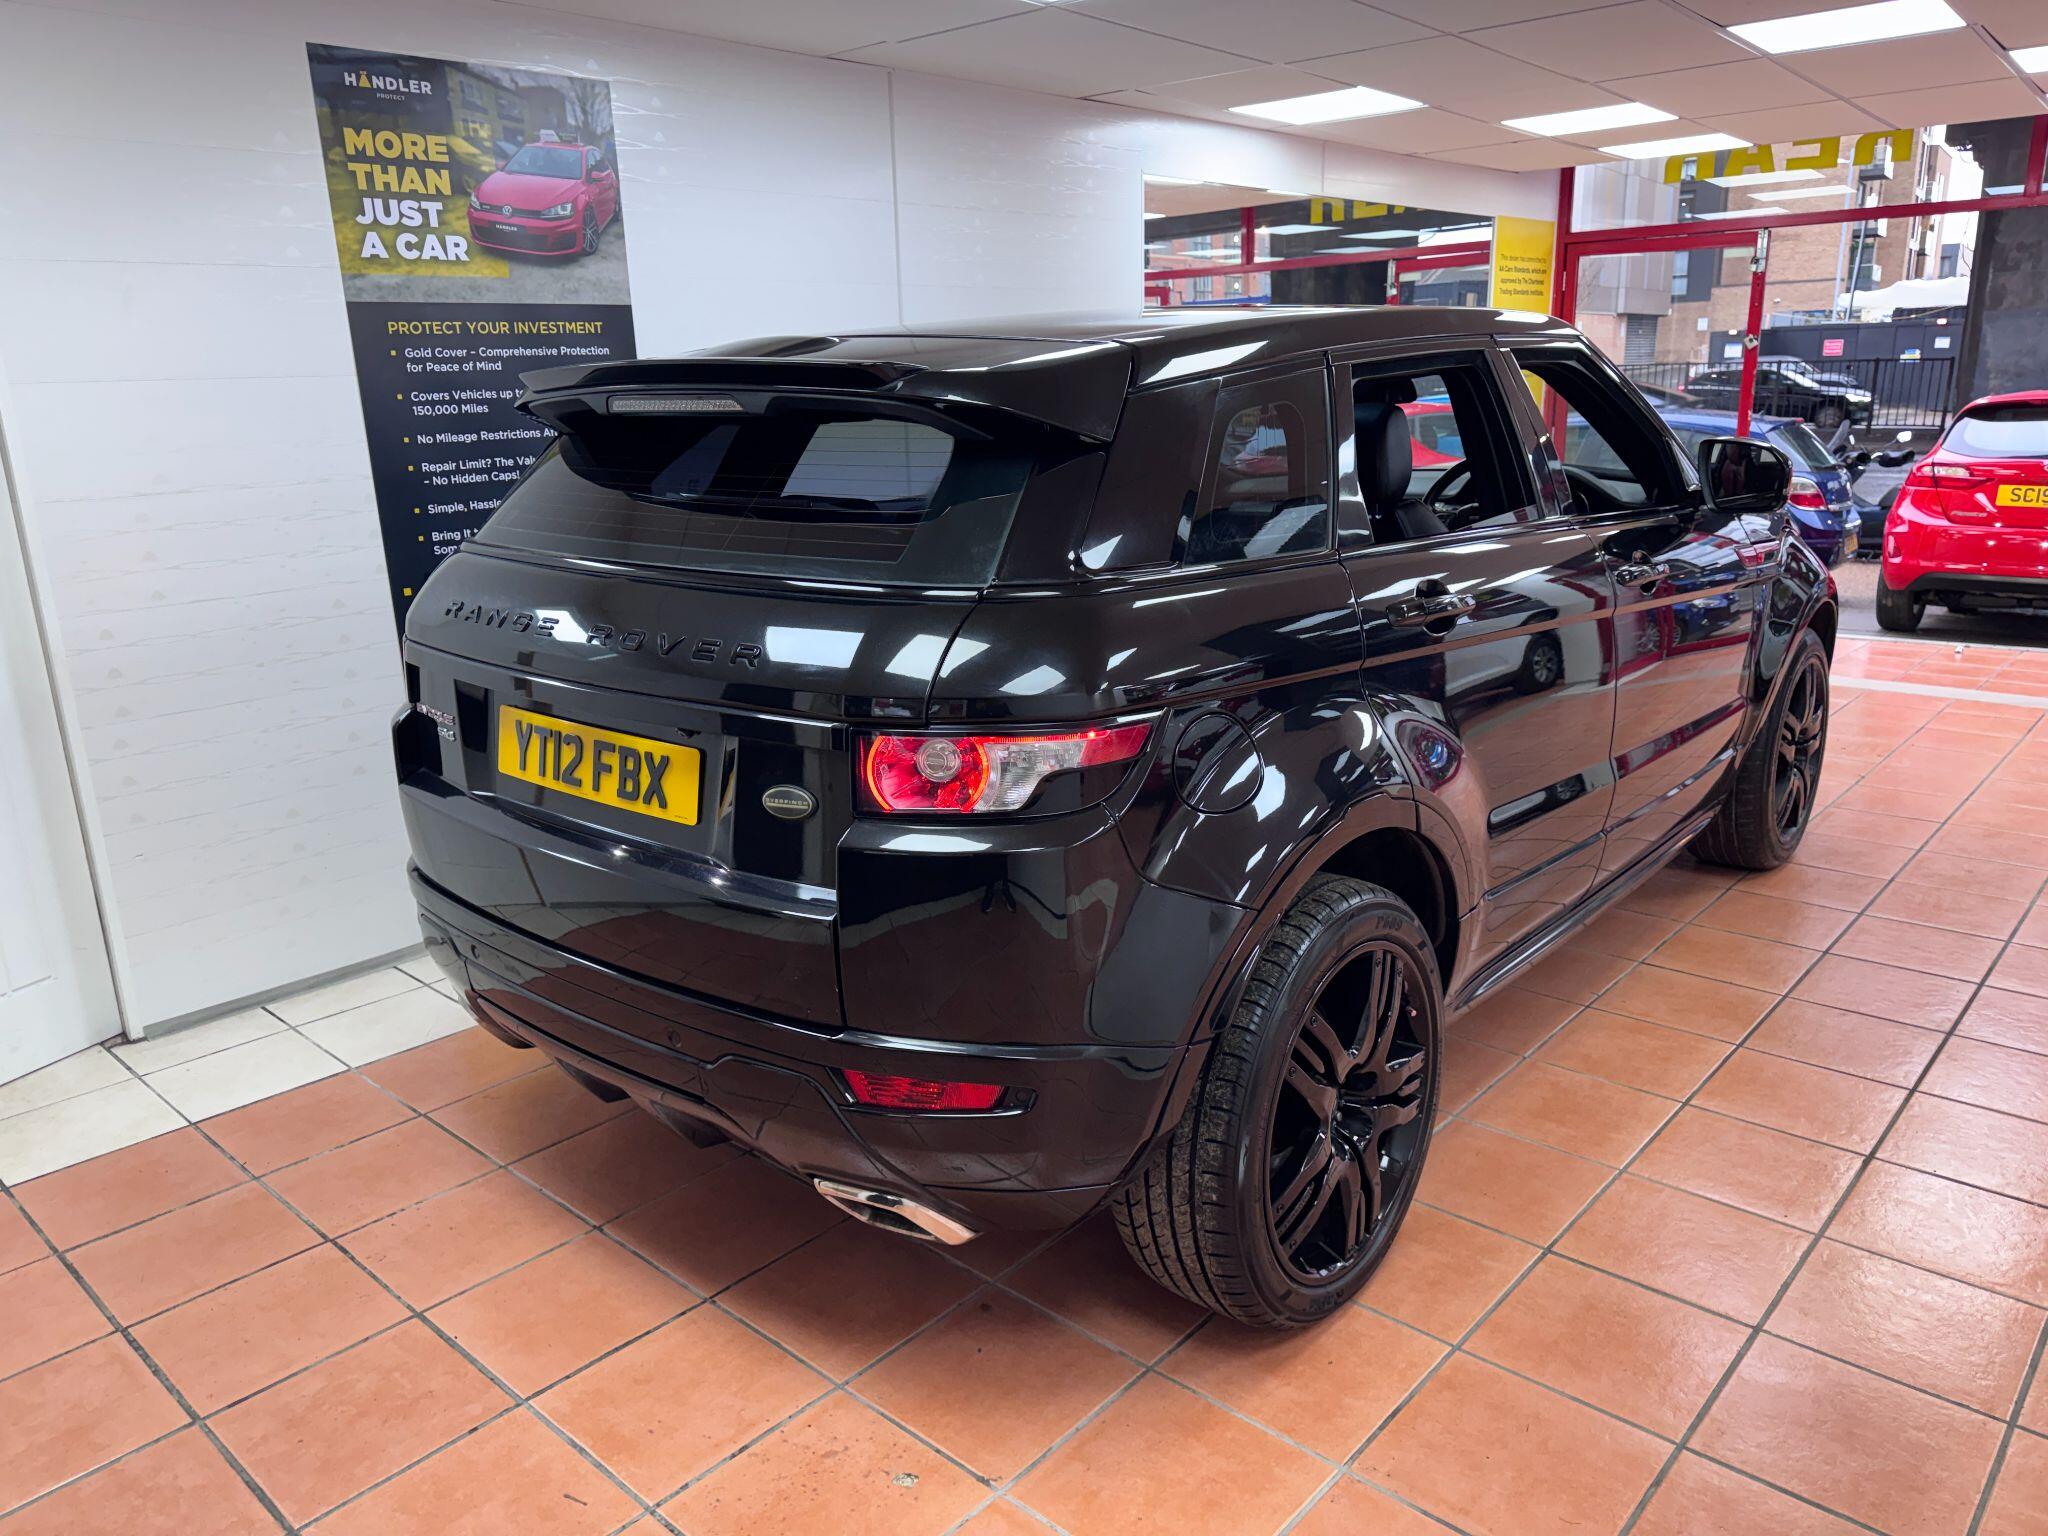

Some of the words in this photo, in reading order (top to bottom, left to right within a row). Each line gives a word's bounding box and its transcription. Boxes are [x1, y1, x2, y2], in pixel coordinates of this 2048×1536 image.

[376, 92, 405, 101] PROTECT
[343, 127, 450, 162] MORE
[347, 162, 452, 196] THAN
[355, 197, 443, 228] JUST
[360, 231, 390, 259] A
[395, 232, 470, 261] CAR
[387, 321, 462, 335] PROTECT
[466, 321, 510, 335] YOUR
[514, 321, 603, 334] INVESTMENT
[404, 347, 432, 358] Gold
[434, 347, 467, 358] Cover
[478, 345, 558, 358] Comprehensive
[560, 345, 610, 356] Protection
[406, 362, 423, 373] for
[426, 362, 460, 373] Peace
[462, 360, 474, 371] of
[476, 360, 502, 371] Mind
[410, 391, 450, 401] Covers
[452, 388, 498, 400] Vehicles
[500, 389, 513, 400] up
[412, 404, 458, 417] 150,000
[461, 403, 489, 414] Miles
[417, 434, 433, 444] No
[436, 432, 478, 444] Mileage
[480, 428, 541, 441] Restrictions
[421, 460, 456, 473] Repair
[459, 457, 491, 470] Limit?
[494, 457, 514, 467] The
[516, 455, 535, 466] Val
[432, 476, 448, 486] No
[451, 474, 489, 485] Hidden
[491, 470, 520, 482] Caps!
[428, 501, 468, 514] Simple,
[431, 530, 460, 542] Bring
[445, 600, 559, 638] RANGE
[585, 622, 763, 668] ROVER
[515, 719, 583, 789] YT12
[592, 739, 670, 810] FBX
